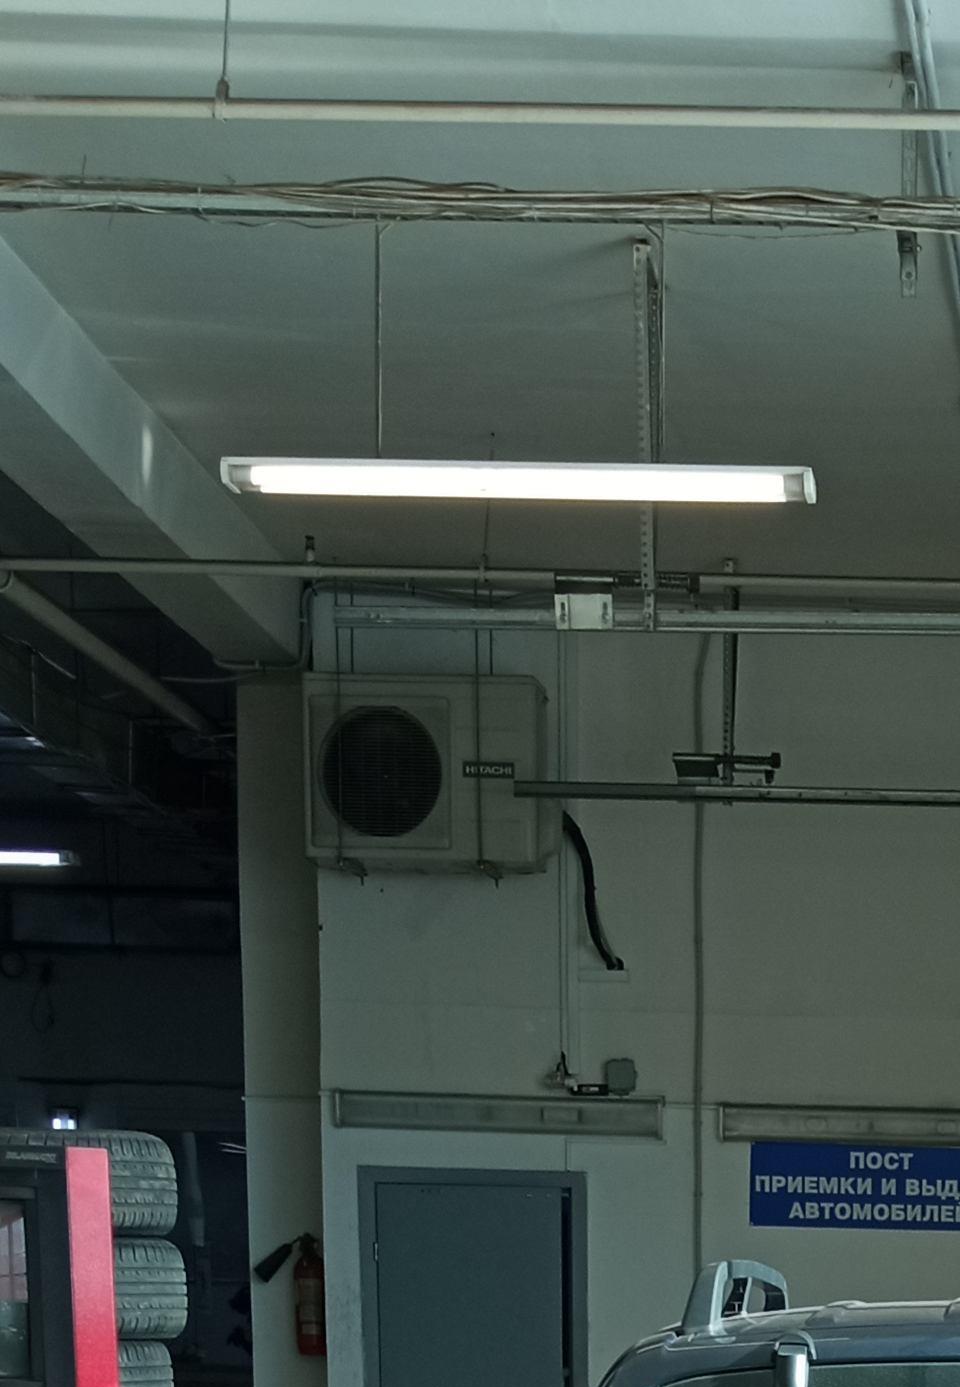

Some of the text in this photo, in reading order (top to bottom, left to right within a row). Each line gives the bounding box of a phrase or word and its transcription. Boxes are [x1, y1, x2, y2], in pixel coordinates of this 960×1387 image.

[465, 765, 512, 775] HITACHI
[849, 1151, 914, 1172] ПОСТ
[754, 1174, 874, 1197] ПРИЕМКИ
[880, 1178, 897, 1196] И
